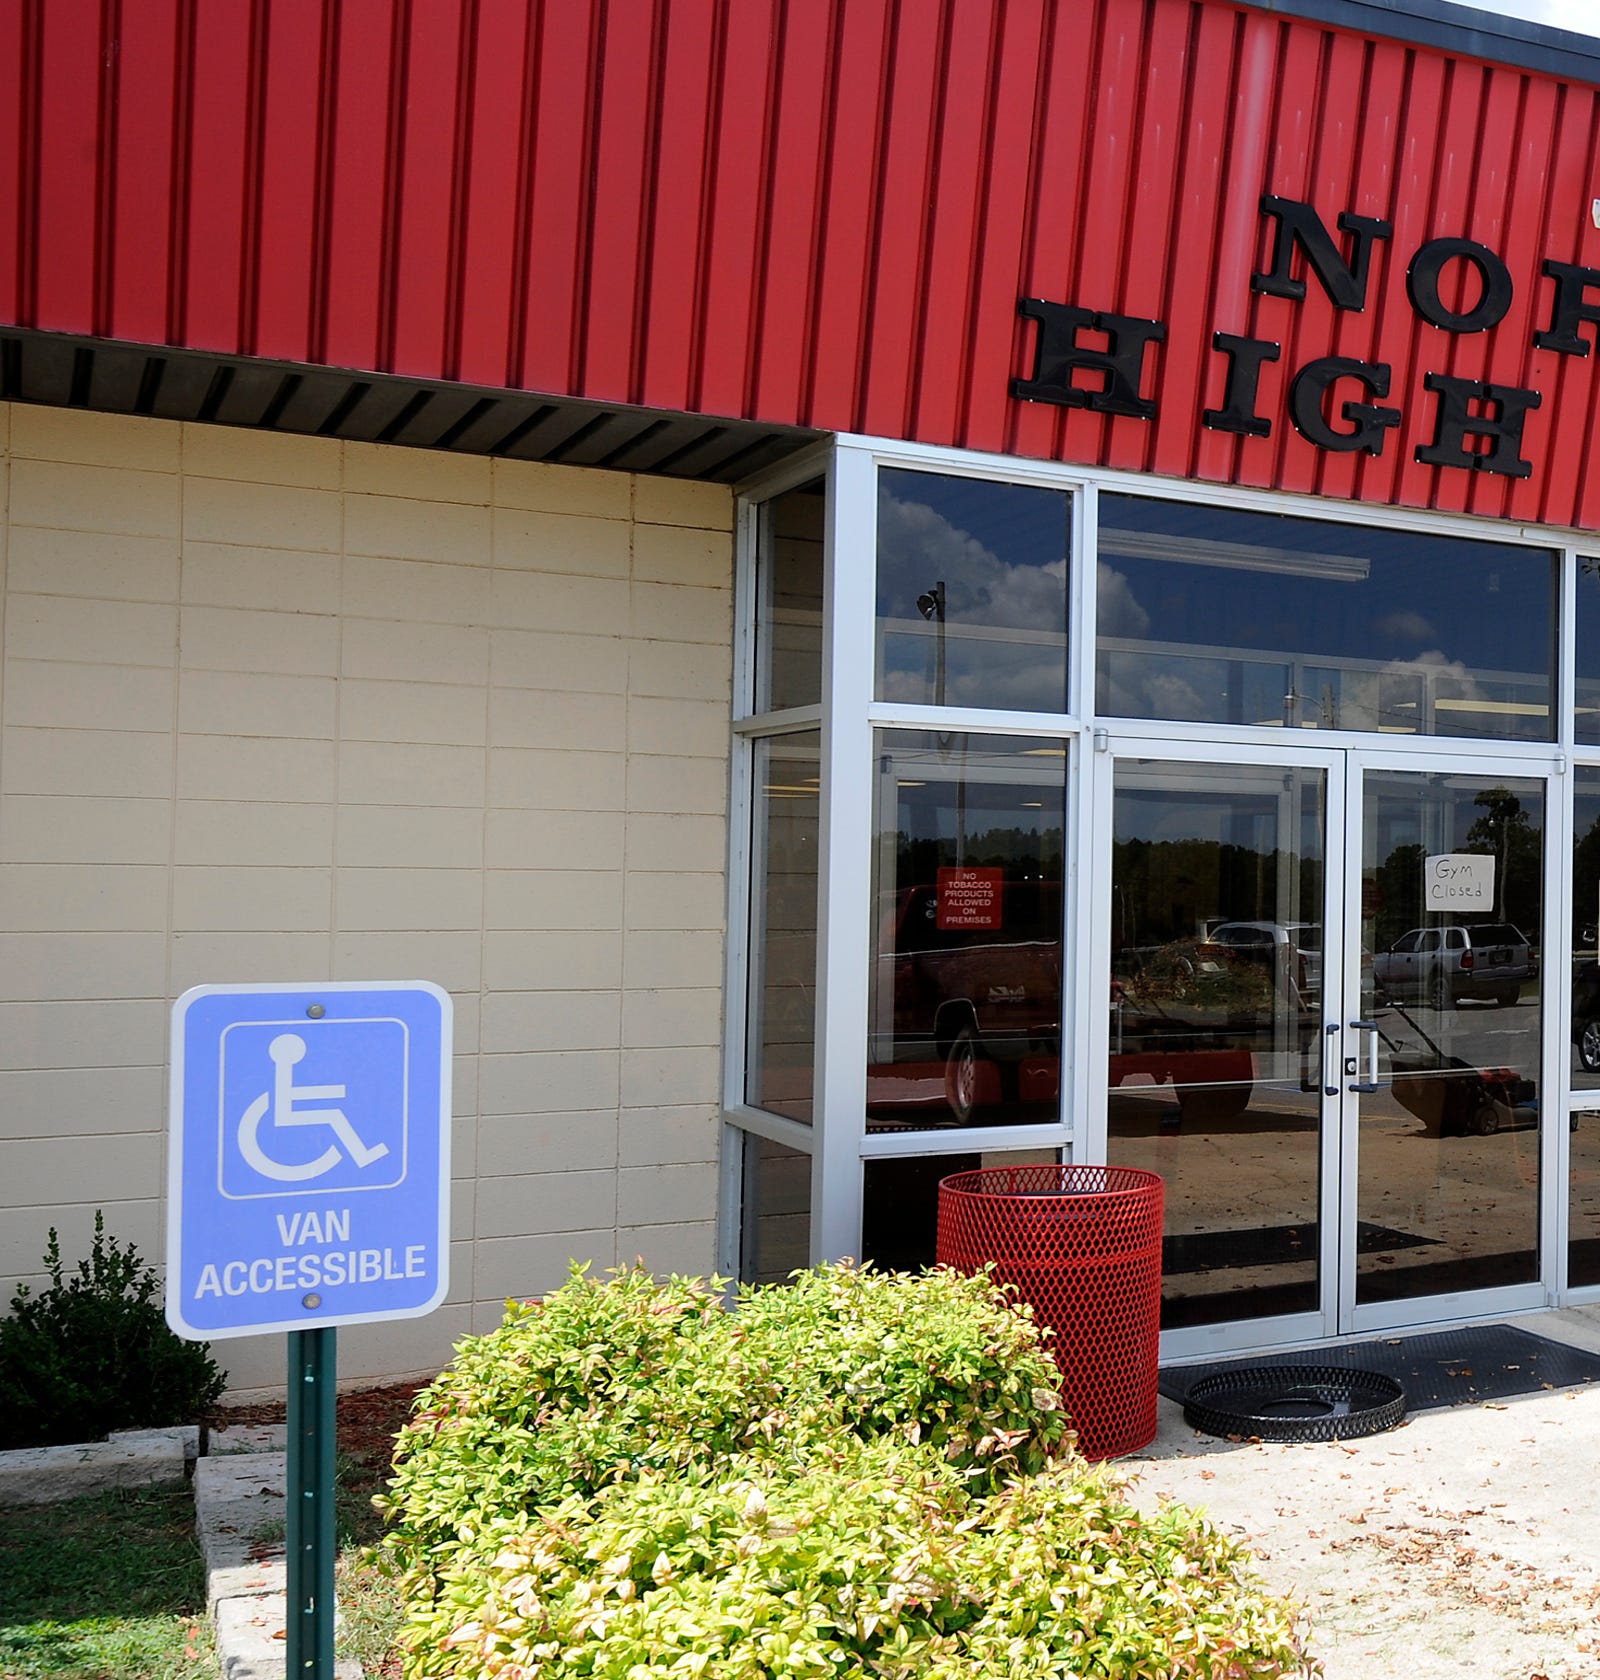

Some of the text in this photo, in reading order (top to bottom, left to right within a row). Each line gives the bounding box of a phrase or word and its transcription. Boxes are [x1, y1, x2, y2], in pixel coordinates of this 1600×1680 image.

[1008, 297, 1543, 479] HIGH
[1435, 859, 1473, 880] Gym
[962, 872, 977, 881] NO
[948, 881, 992, 889] TOBACCO
[944, 890, 994, 898] PRODUCTS
[1432, 881, 1482, 899] Closed
[947, 898, 992, 907] ALLOWED
[962, 907, 977, 916] ON
[945, 916, 992, 925] PREMISES
[276, 1209, 350, 1246] VAN
[194, 1245, 427, 1299] ACCESSIBLE
